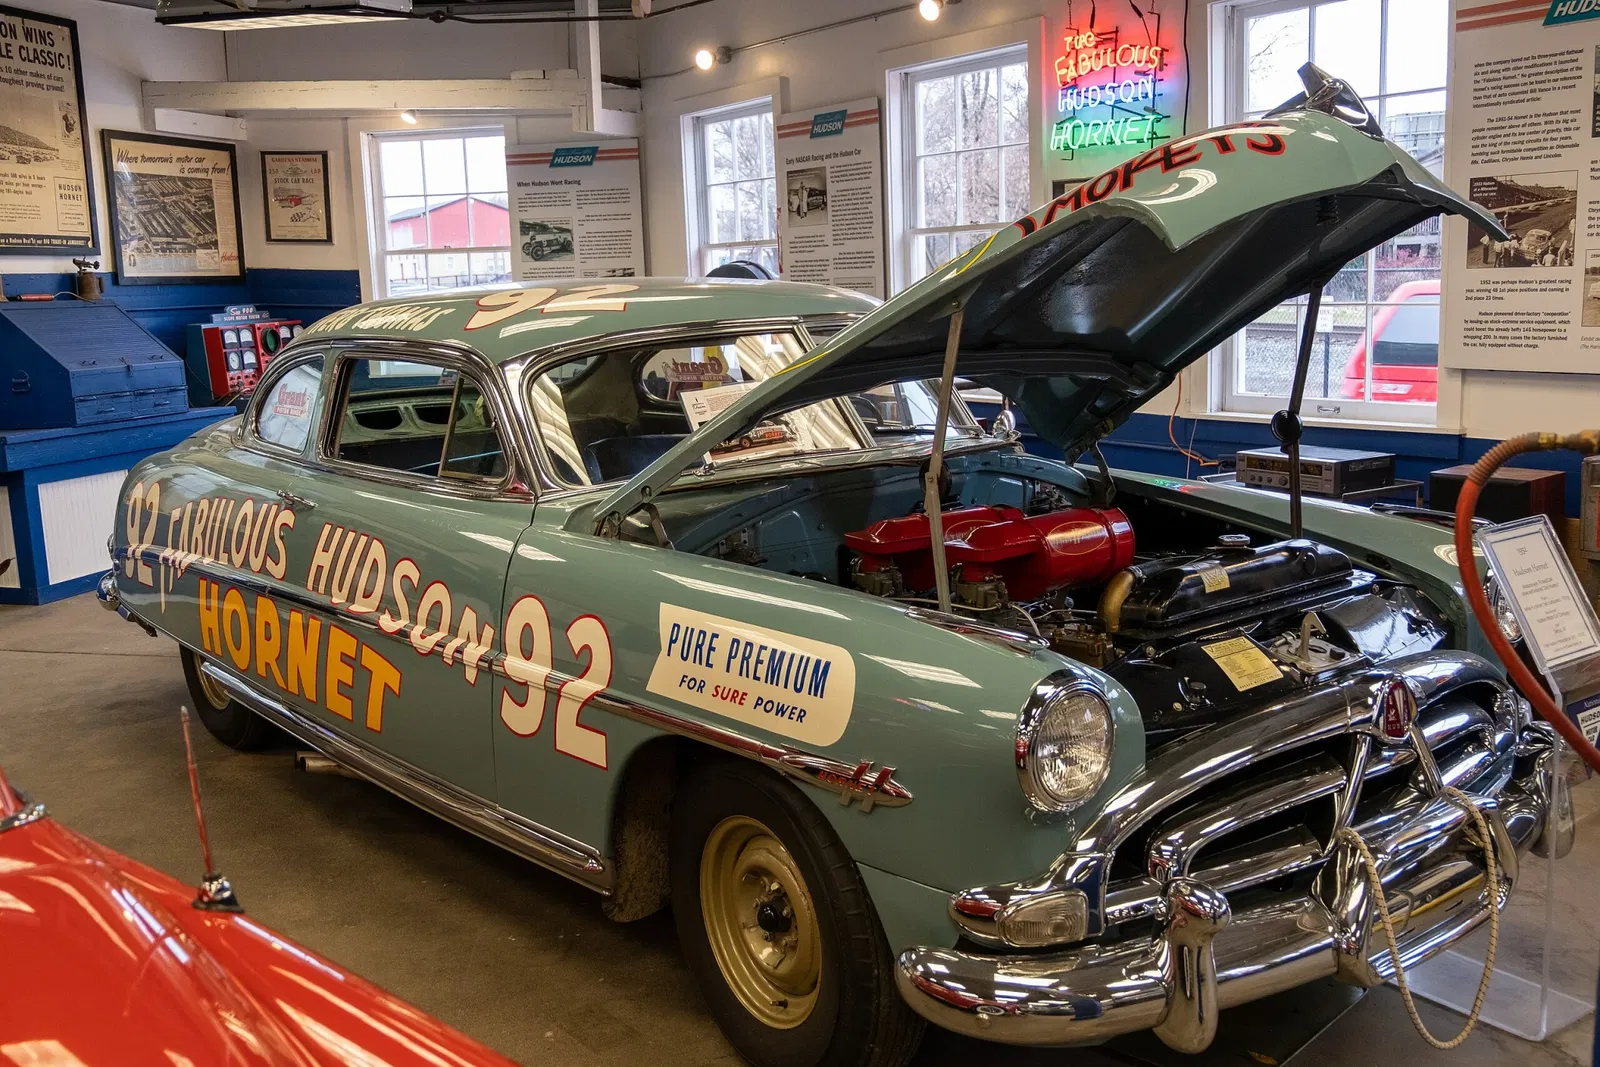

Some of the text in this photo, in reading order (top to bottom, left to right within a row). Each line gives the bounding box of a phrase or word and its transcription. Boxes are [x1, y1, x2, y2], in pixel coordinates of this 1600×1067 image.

[22, 26, 55, 47] WINS
[19, 45, 71, 70] CLASSIC!
[1055, 44, 1162, 86] FABULOUS
[14, 68, 28, 77] other
[29, 70, 45, 80] makes
[25, 81, 44, 90] proving
[1058, 75, 1154, 112] HUDSON
[813, 121, 842, 133] HUDSON
[1050, 116, 1158, 150] HORNET
[116, 148, 138, 164] Where
[140, 153, 173, 165] tomorrow's
[176, 155, 193, 164] motor
[554, 155, 592, 164] HUDSON
[796, 155, 810, 164] NASCAR
[811, 153, 824, 162] Racing
[840, 149, 853, 157] Hudson
[180, 163, 230, 176] is coming from!
[58, 184, 82, 192] HUDSON
[59, 193, 83, 202] HORNET
[464, 284, 640, 331] 92
[278, 384, 307, 407] Grant
[1512, 562, 1549, 576] Hudson Hornet
[124, 482, 495, 685] 92 FABULOUS HUDSON
[199, 577, 402, 734] HORNET
[666, 622, 832, 699] PURE PREMIUM
[499, 594, 613, 770] 92
[678, 674, 808, 724] FOR SURE POWER
[817, 770, 877, 796] HORNET
